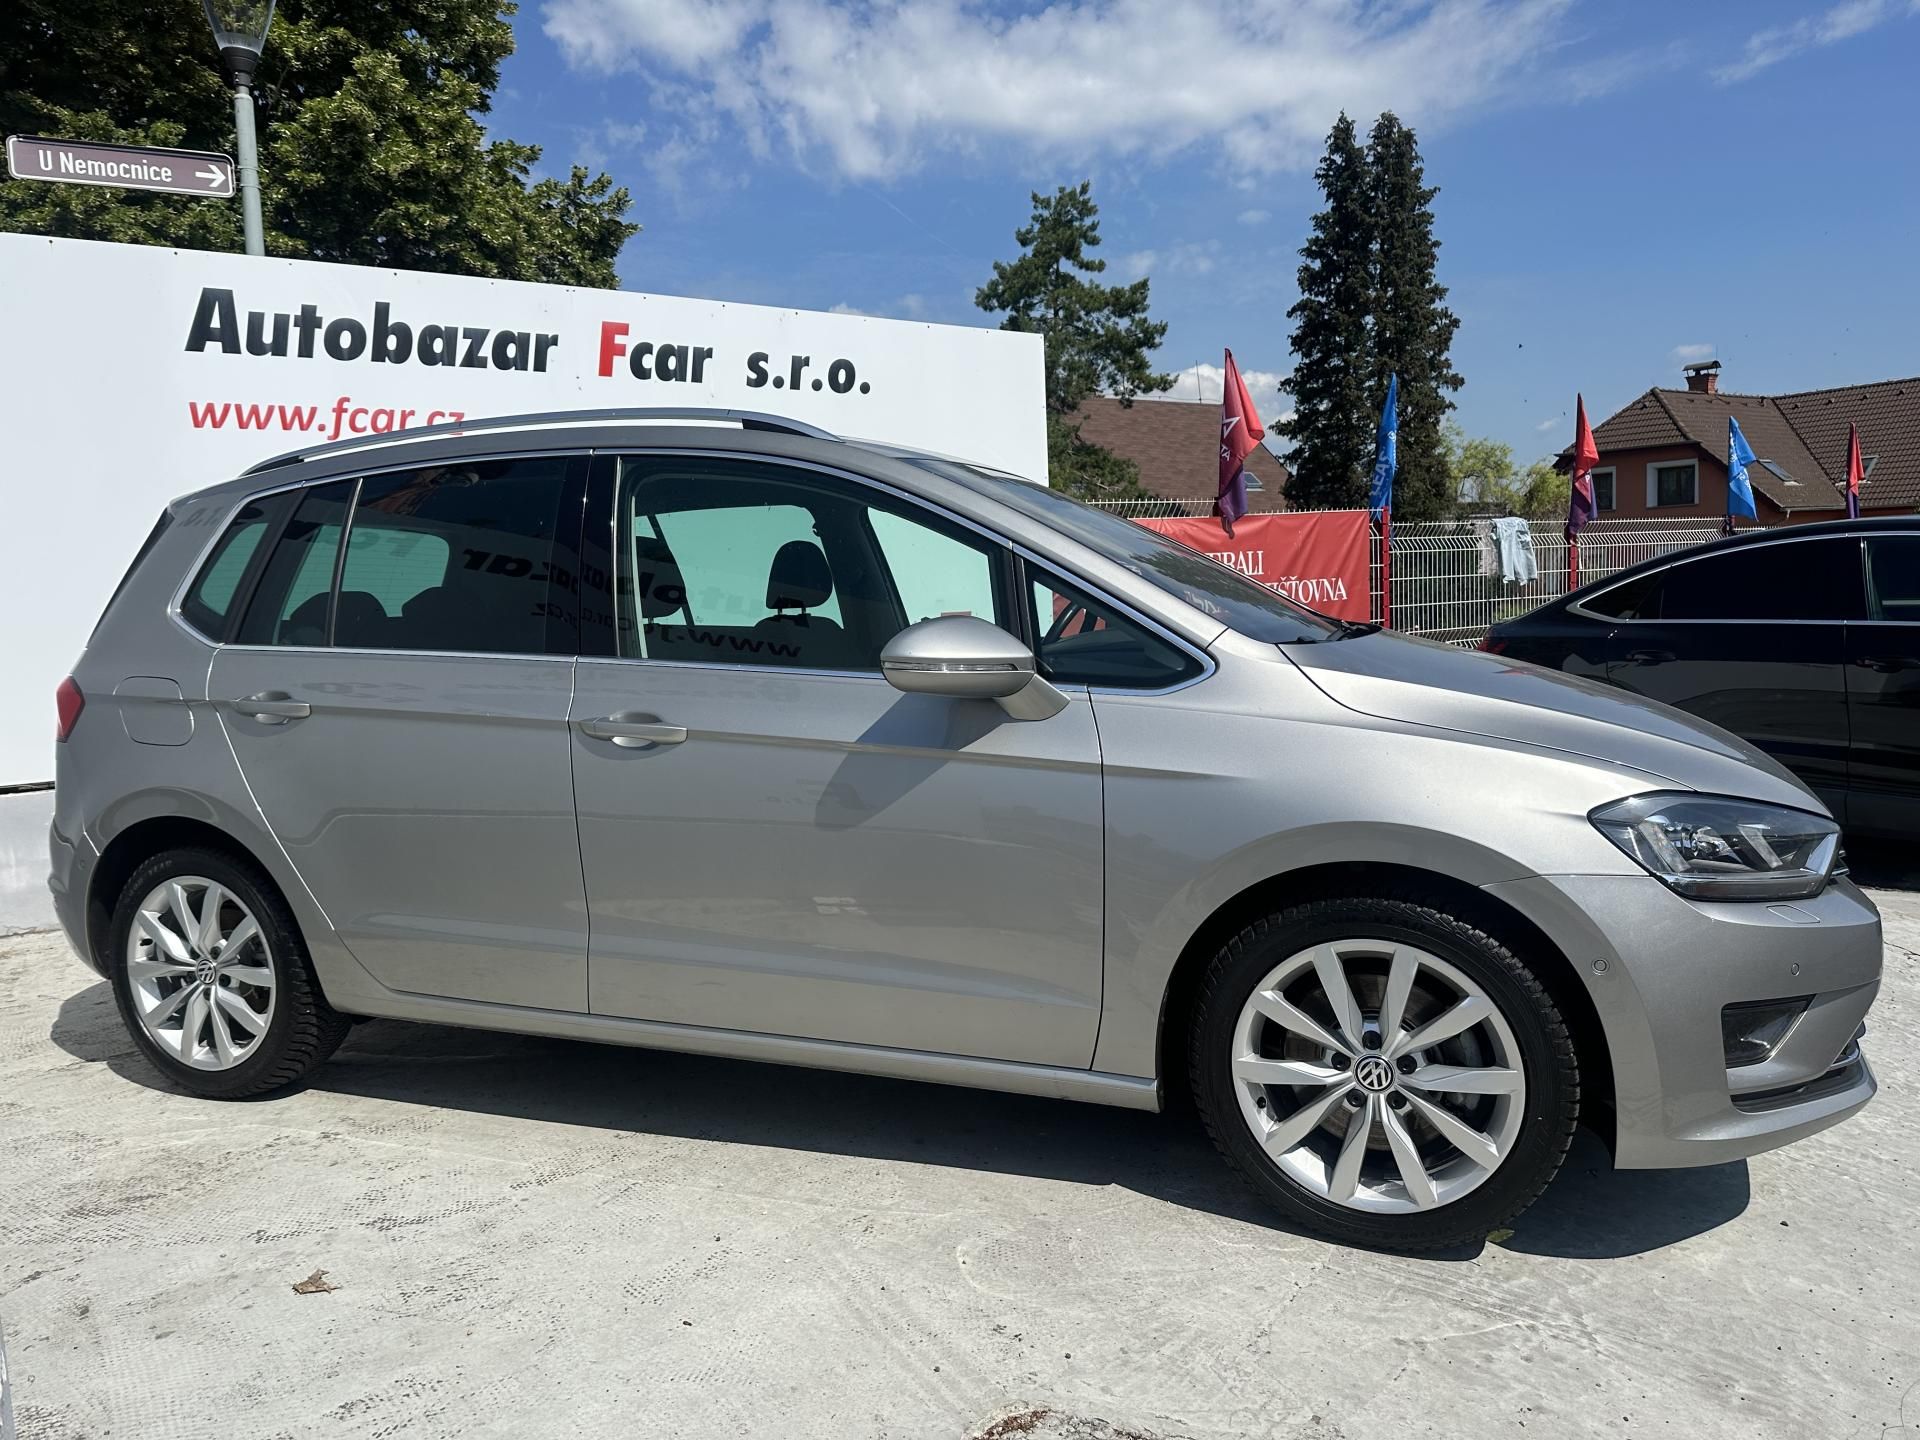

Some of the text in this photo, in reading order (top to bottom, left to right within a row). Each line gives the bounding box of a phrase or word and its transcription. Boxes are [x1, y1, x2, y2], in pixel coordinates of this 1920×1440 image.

[38, 149, 173, 182] U Nemocnice
[185, 287, 872, 394] Autobazar Fcar s.r.o.
[188, 396, 466, 441] www.fcarcz
[1205, 550, 1265, 576] RALI
[1264, 575, 1348, 604] ŠŤOVNA
